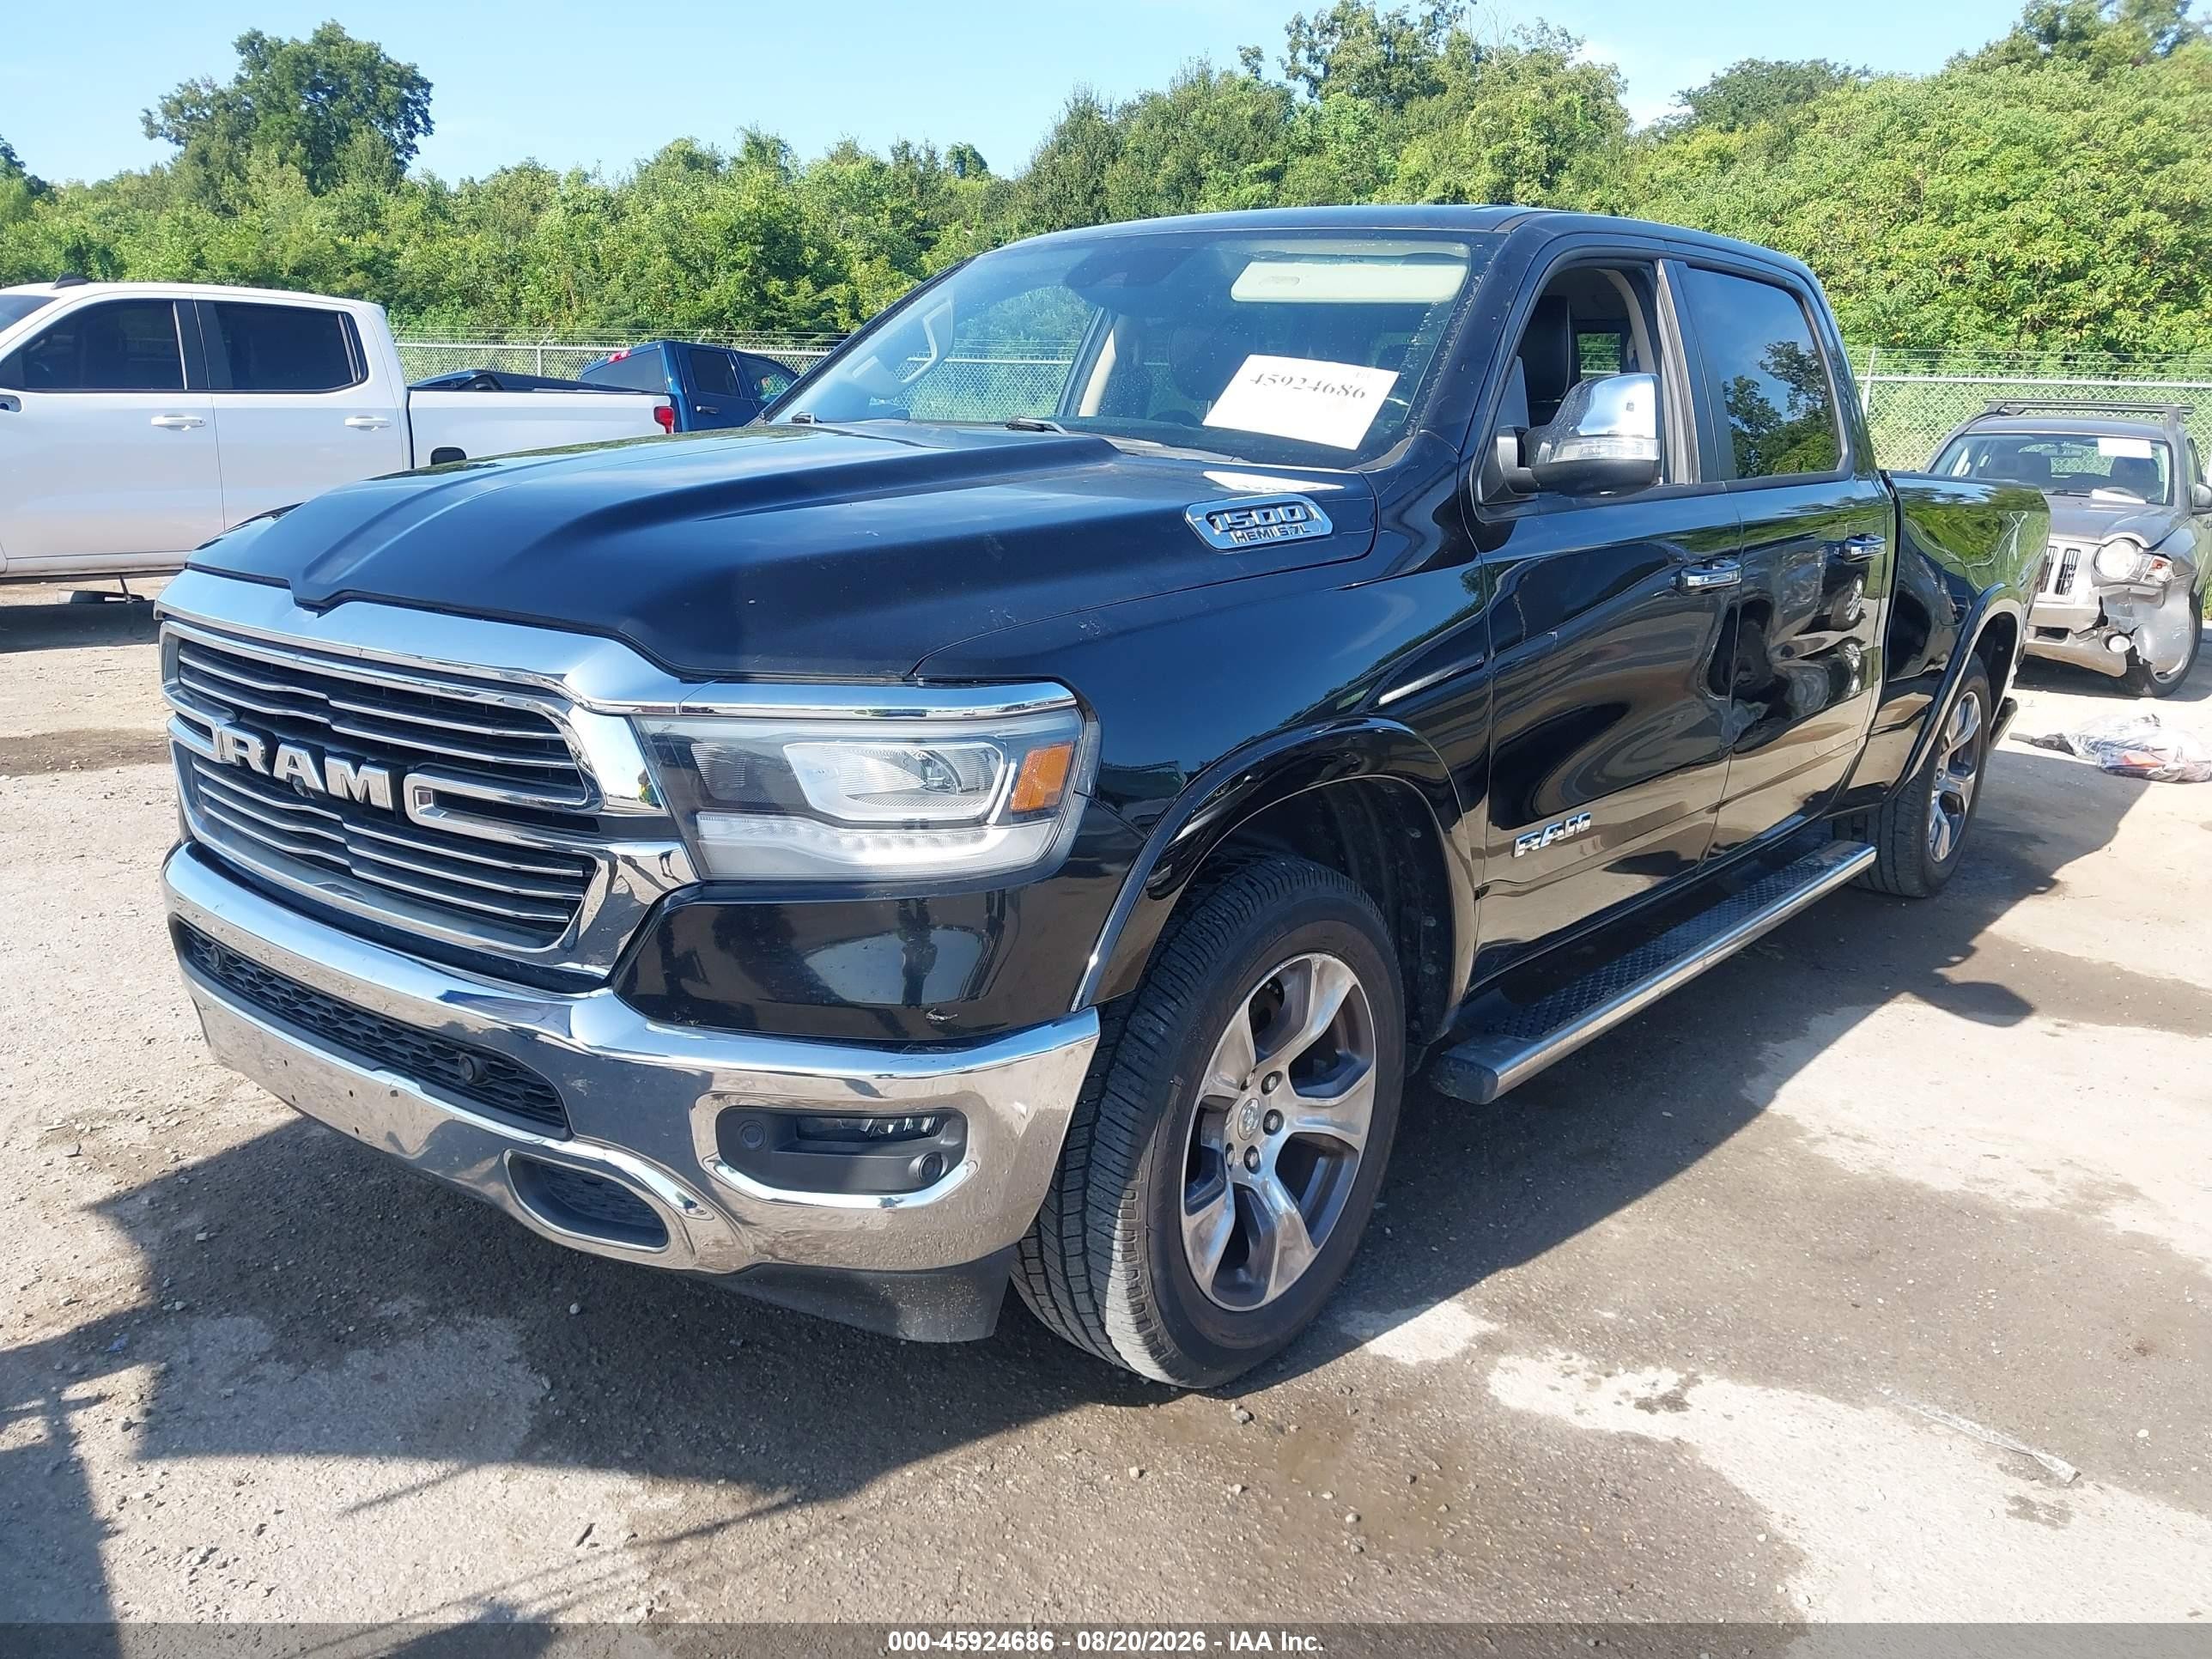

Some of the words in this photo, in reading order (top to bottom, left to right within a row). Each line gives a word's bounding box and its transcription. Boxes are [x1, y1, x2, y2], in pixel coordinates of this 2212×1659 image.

[1210, 505, 1309, 532] 1500
[1235, 528, 1276, 544] HEMI
[1279, 525, 1311, 538] 5.7L
[222, 721, 394, 811] RAM
[1513, 811, 1592, 858] RAM
